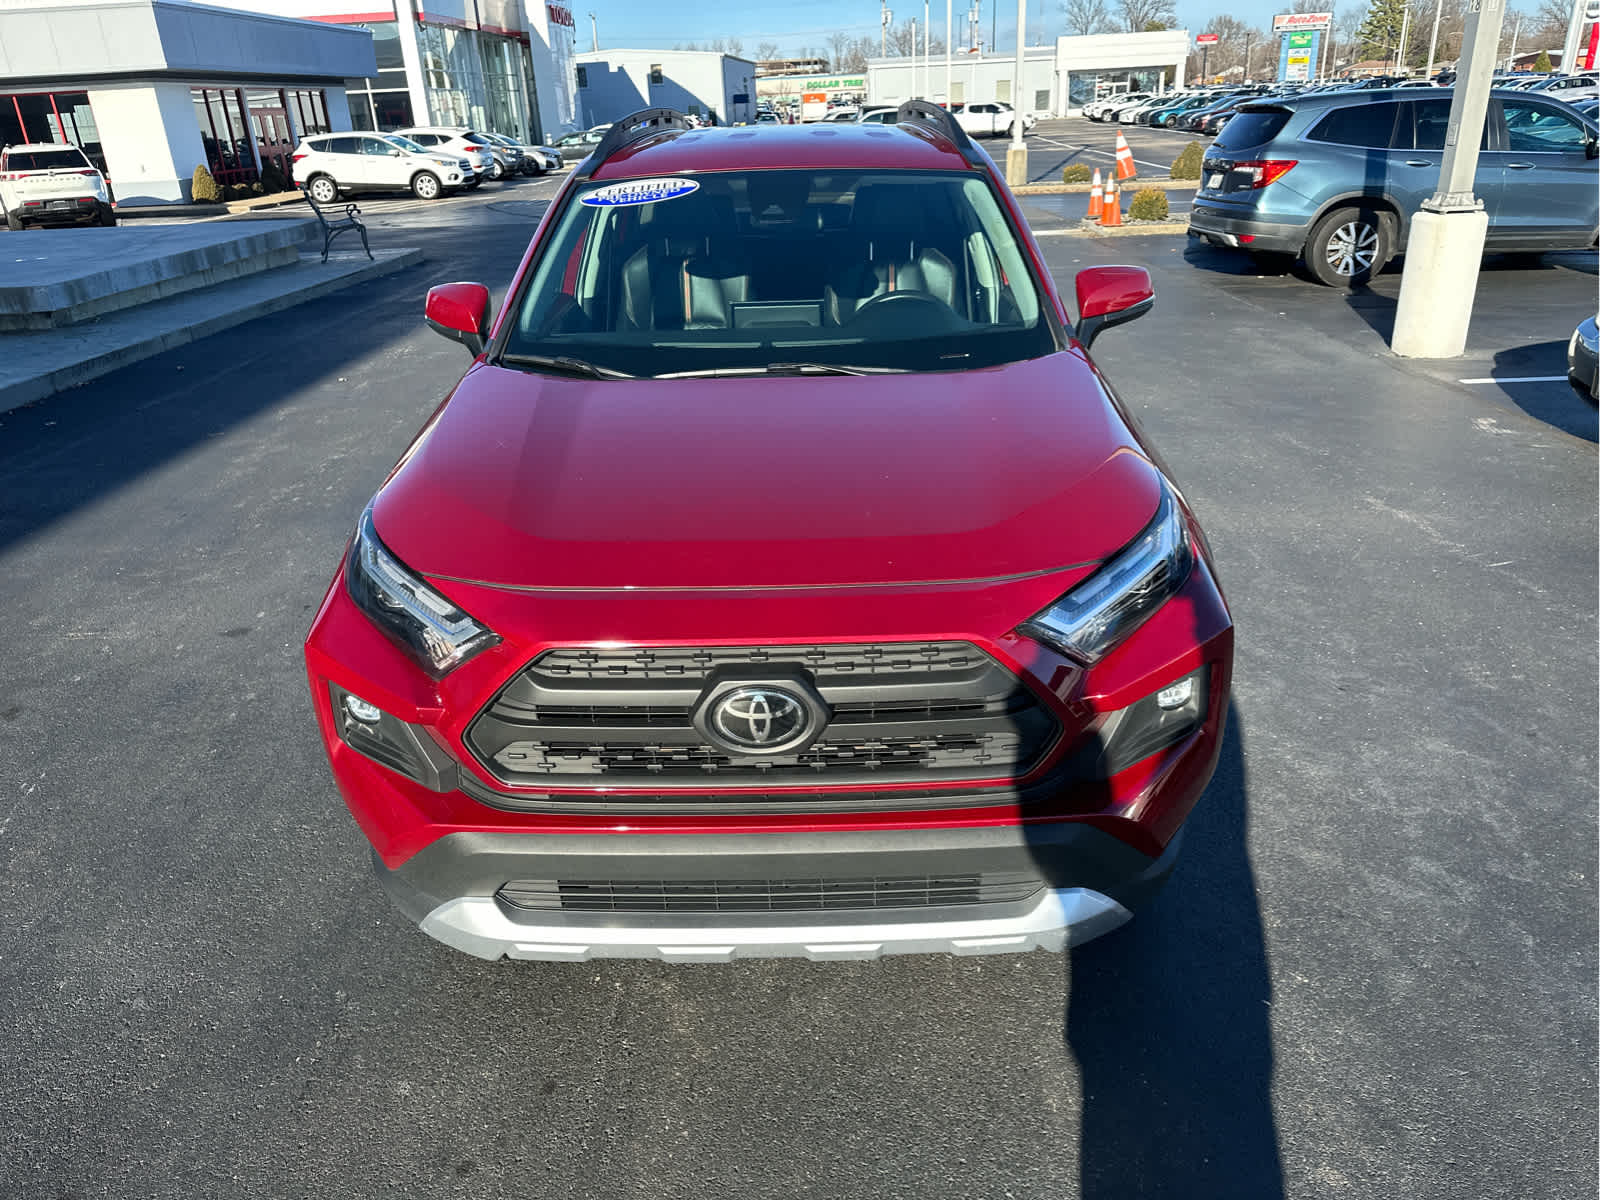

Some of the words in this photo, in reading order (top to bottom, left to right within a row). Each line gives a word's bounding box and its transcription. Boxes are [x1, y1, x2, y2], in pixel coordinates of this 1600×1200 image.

[806, 81, 840, 89] DOLLAR
[843, 79, 864, 87] TREE
[595, 181, 686, 198] CERTIFIED
